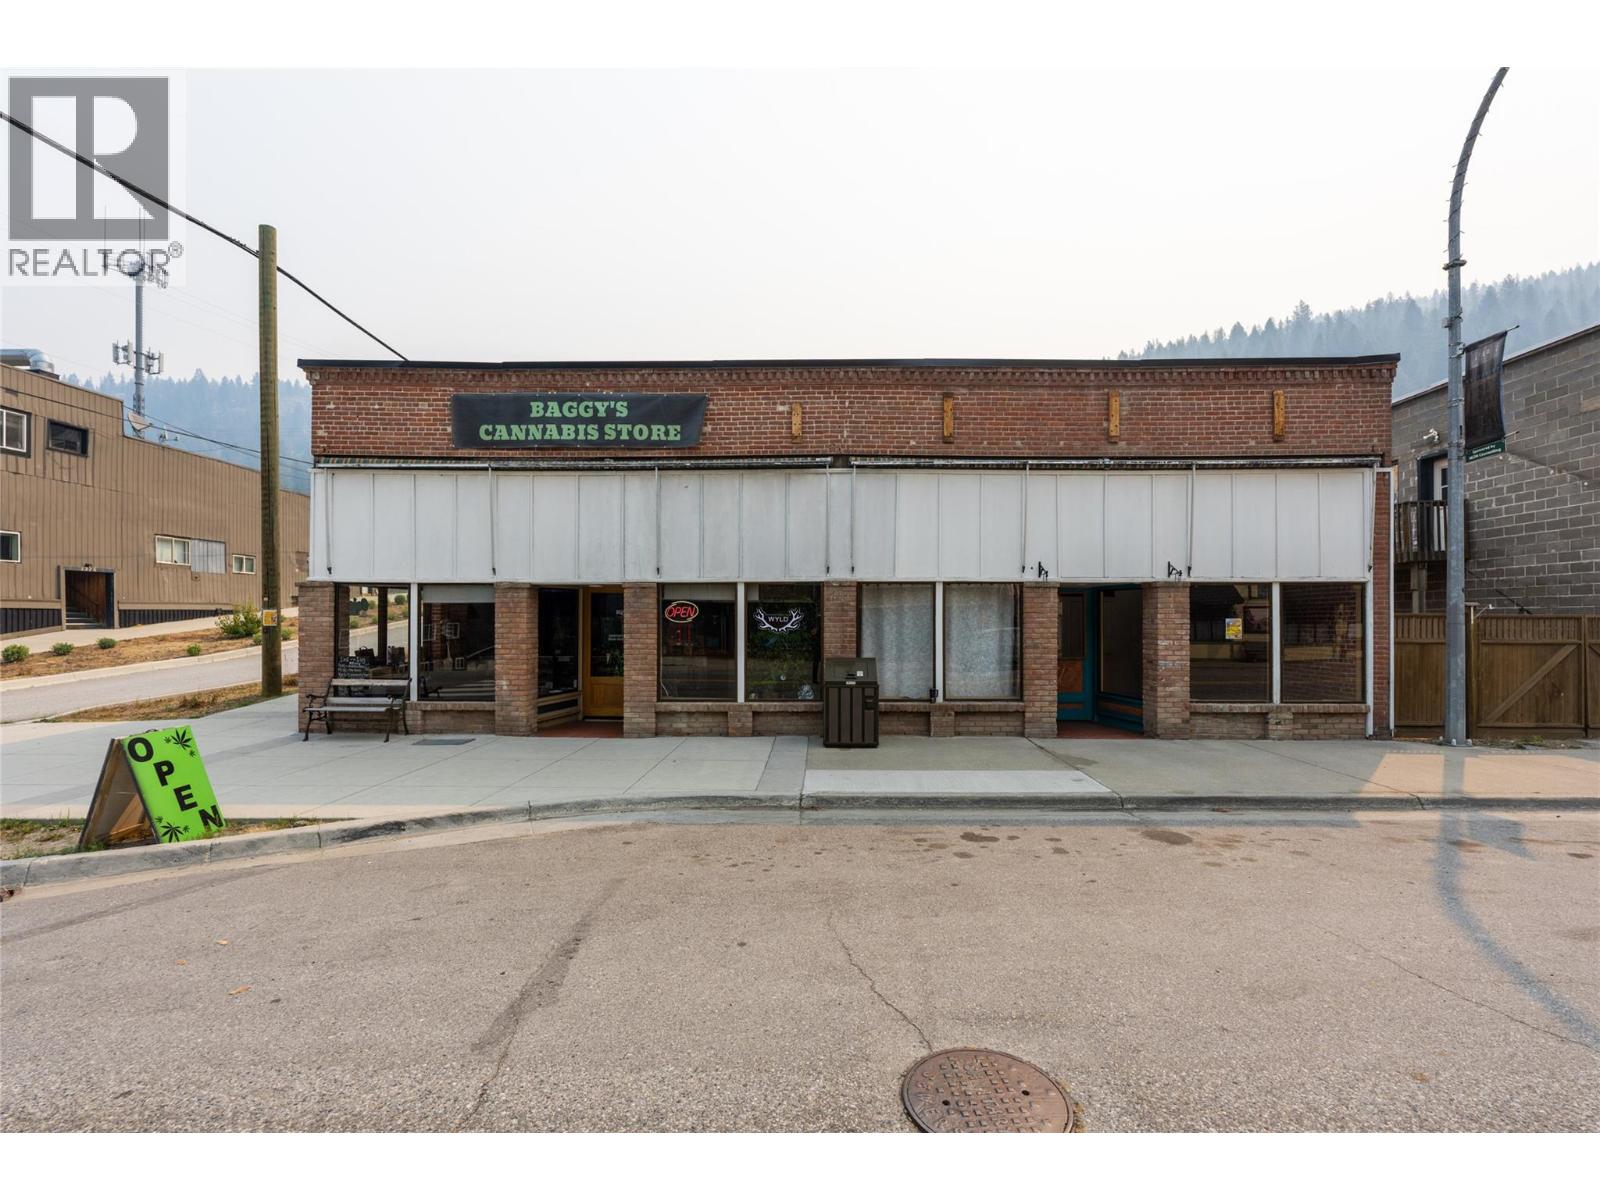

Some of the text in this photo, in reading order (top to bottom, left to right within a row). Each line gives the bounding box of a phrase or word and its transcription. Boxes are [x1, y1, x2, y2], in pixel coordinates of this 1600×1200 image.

[529, 401, 629, 418] BAGGY'S
[479, 424, 681, 441] CANNABIS STORE
[666, 606, 697, 618] OPEN
[768, 615, 789, 623] WYLD
[127, 737, 224, 832] OPEN
